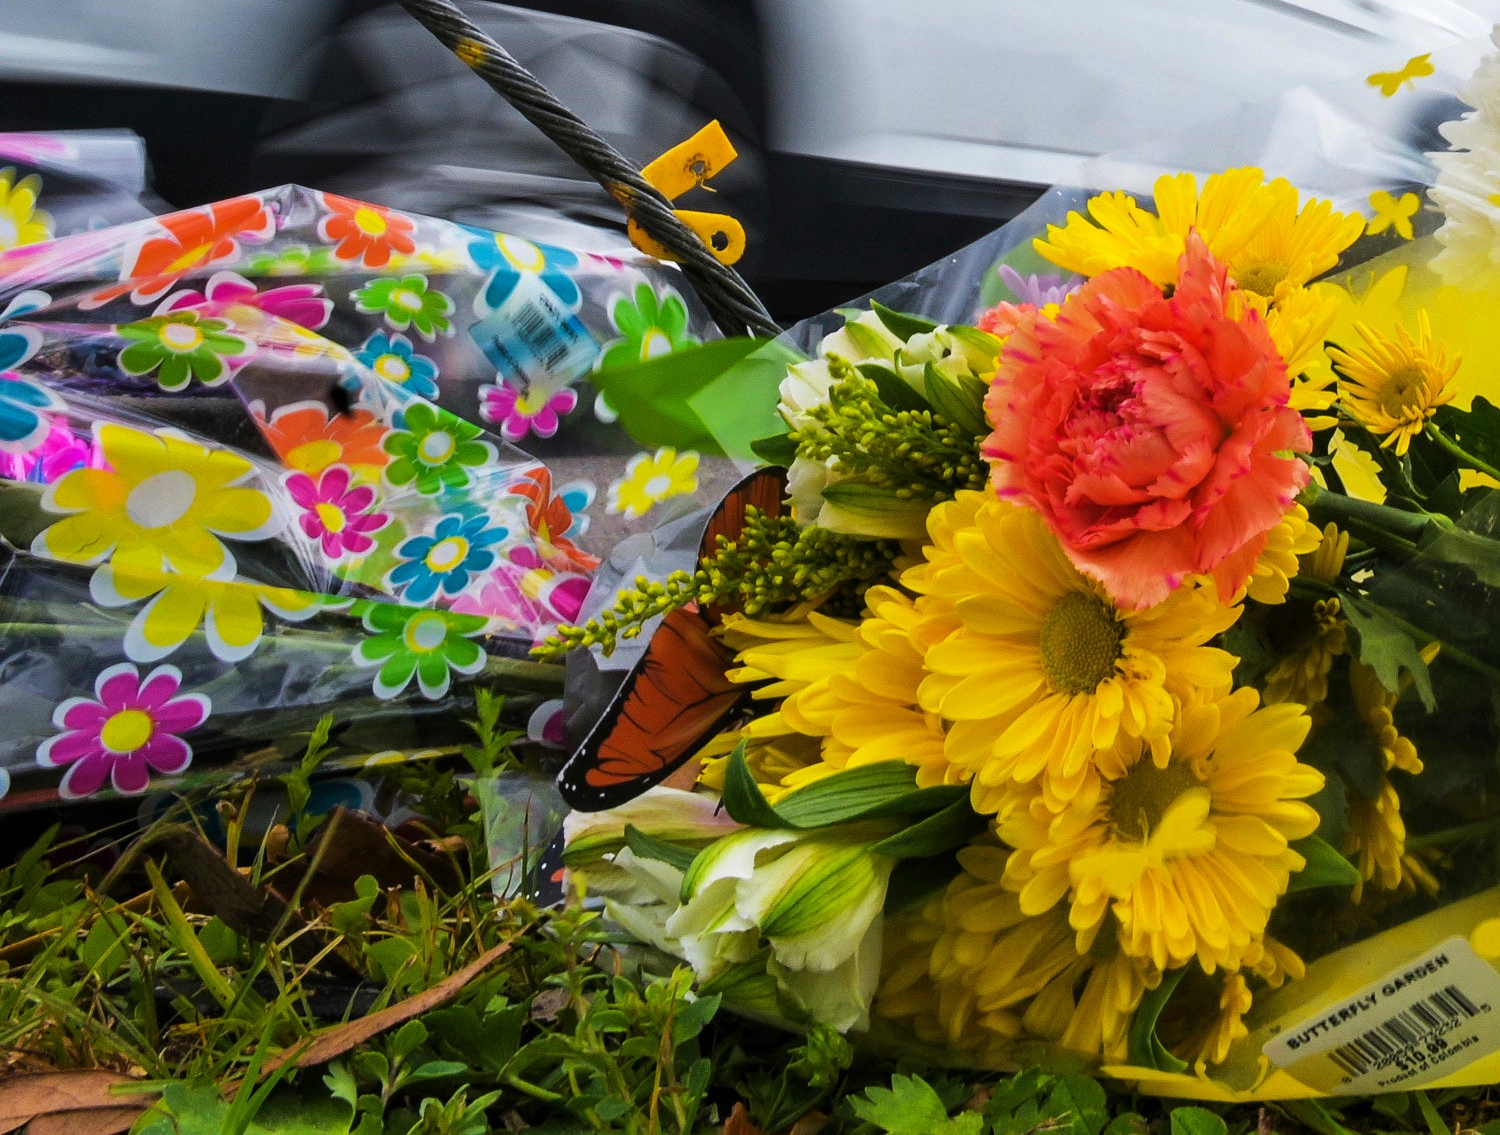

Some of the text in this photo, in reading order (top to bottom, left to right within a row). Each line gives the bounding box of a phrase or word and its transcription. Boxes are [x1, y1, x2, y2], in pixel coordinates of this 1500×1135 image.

[1286, 953, 1449, 1050] BUTTERFLY GARDEN
[1378, 1034, 1480, 1087] Product of Colombia
[1395, 1037, 1448, 1071] $10.99
